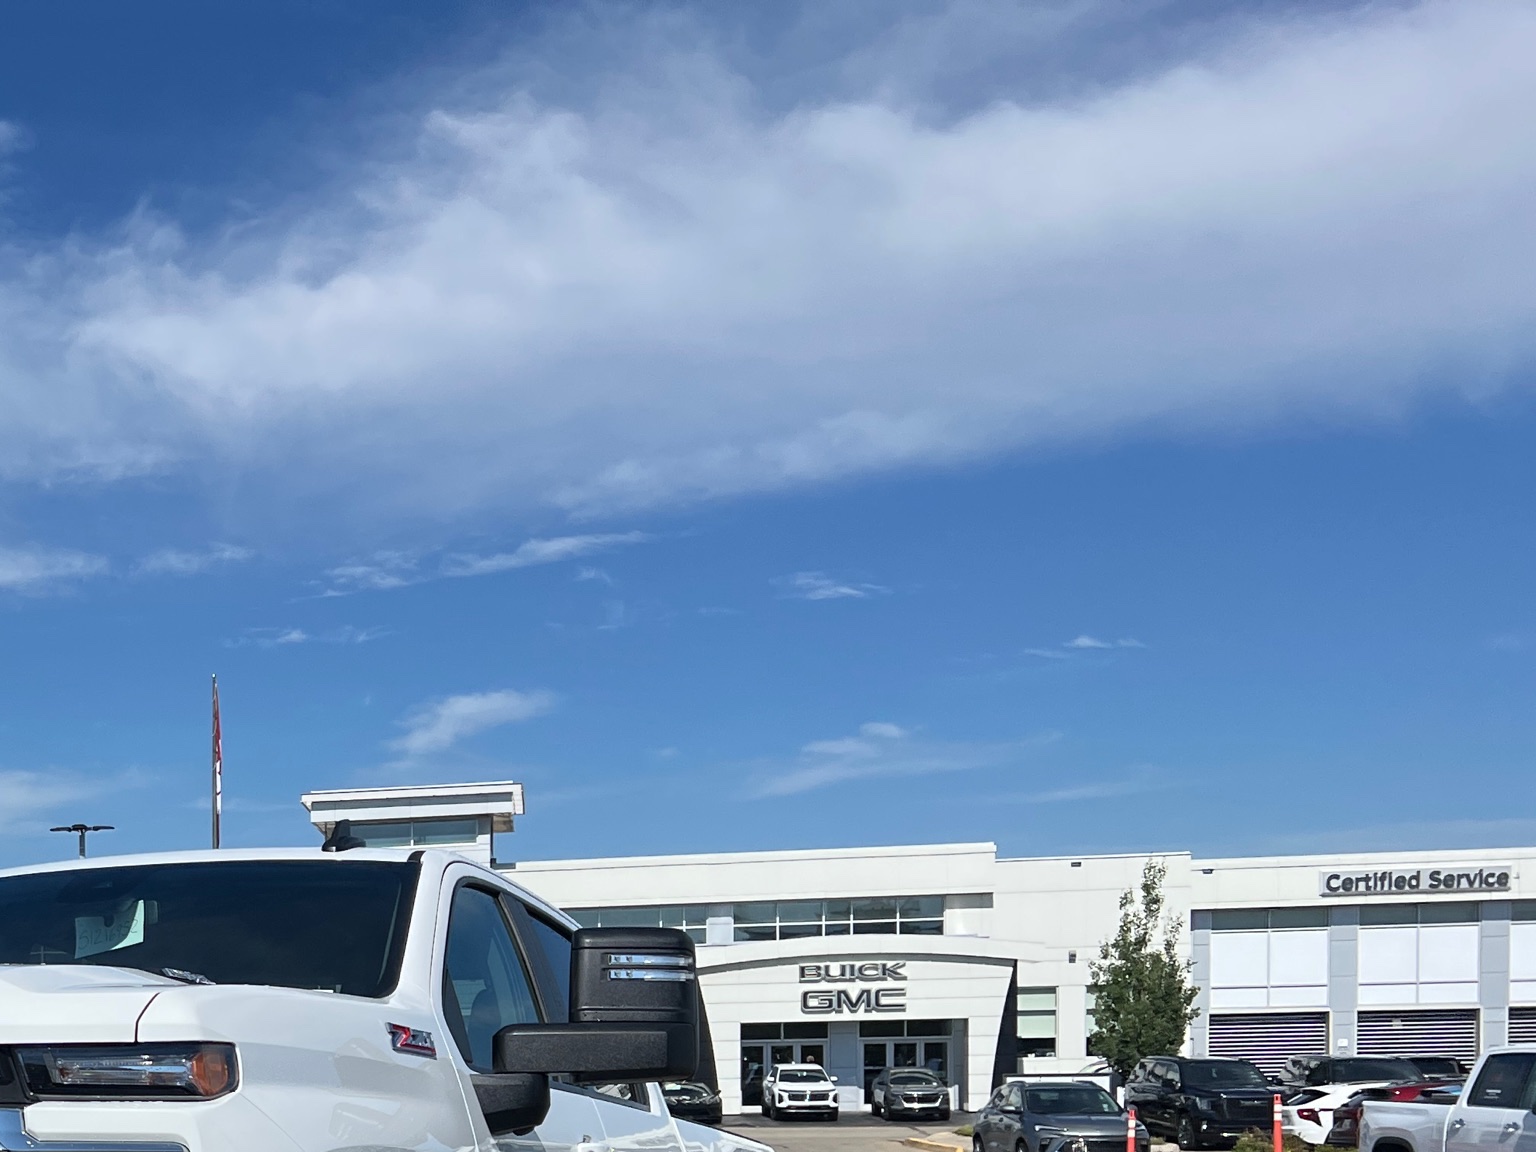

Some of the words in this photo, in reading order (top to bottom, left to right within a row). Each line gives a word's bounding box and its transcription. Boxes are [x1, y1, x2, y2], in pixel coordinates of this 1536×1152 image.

[1325, 871, 1421, 892] Certified
[1428, 868, 1510, 889] Service
[799, 961, 907, 983] BUICK
[801, 988, 906, 1014] GMC
